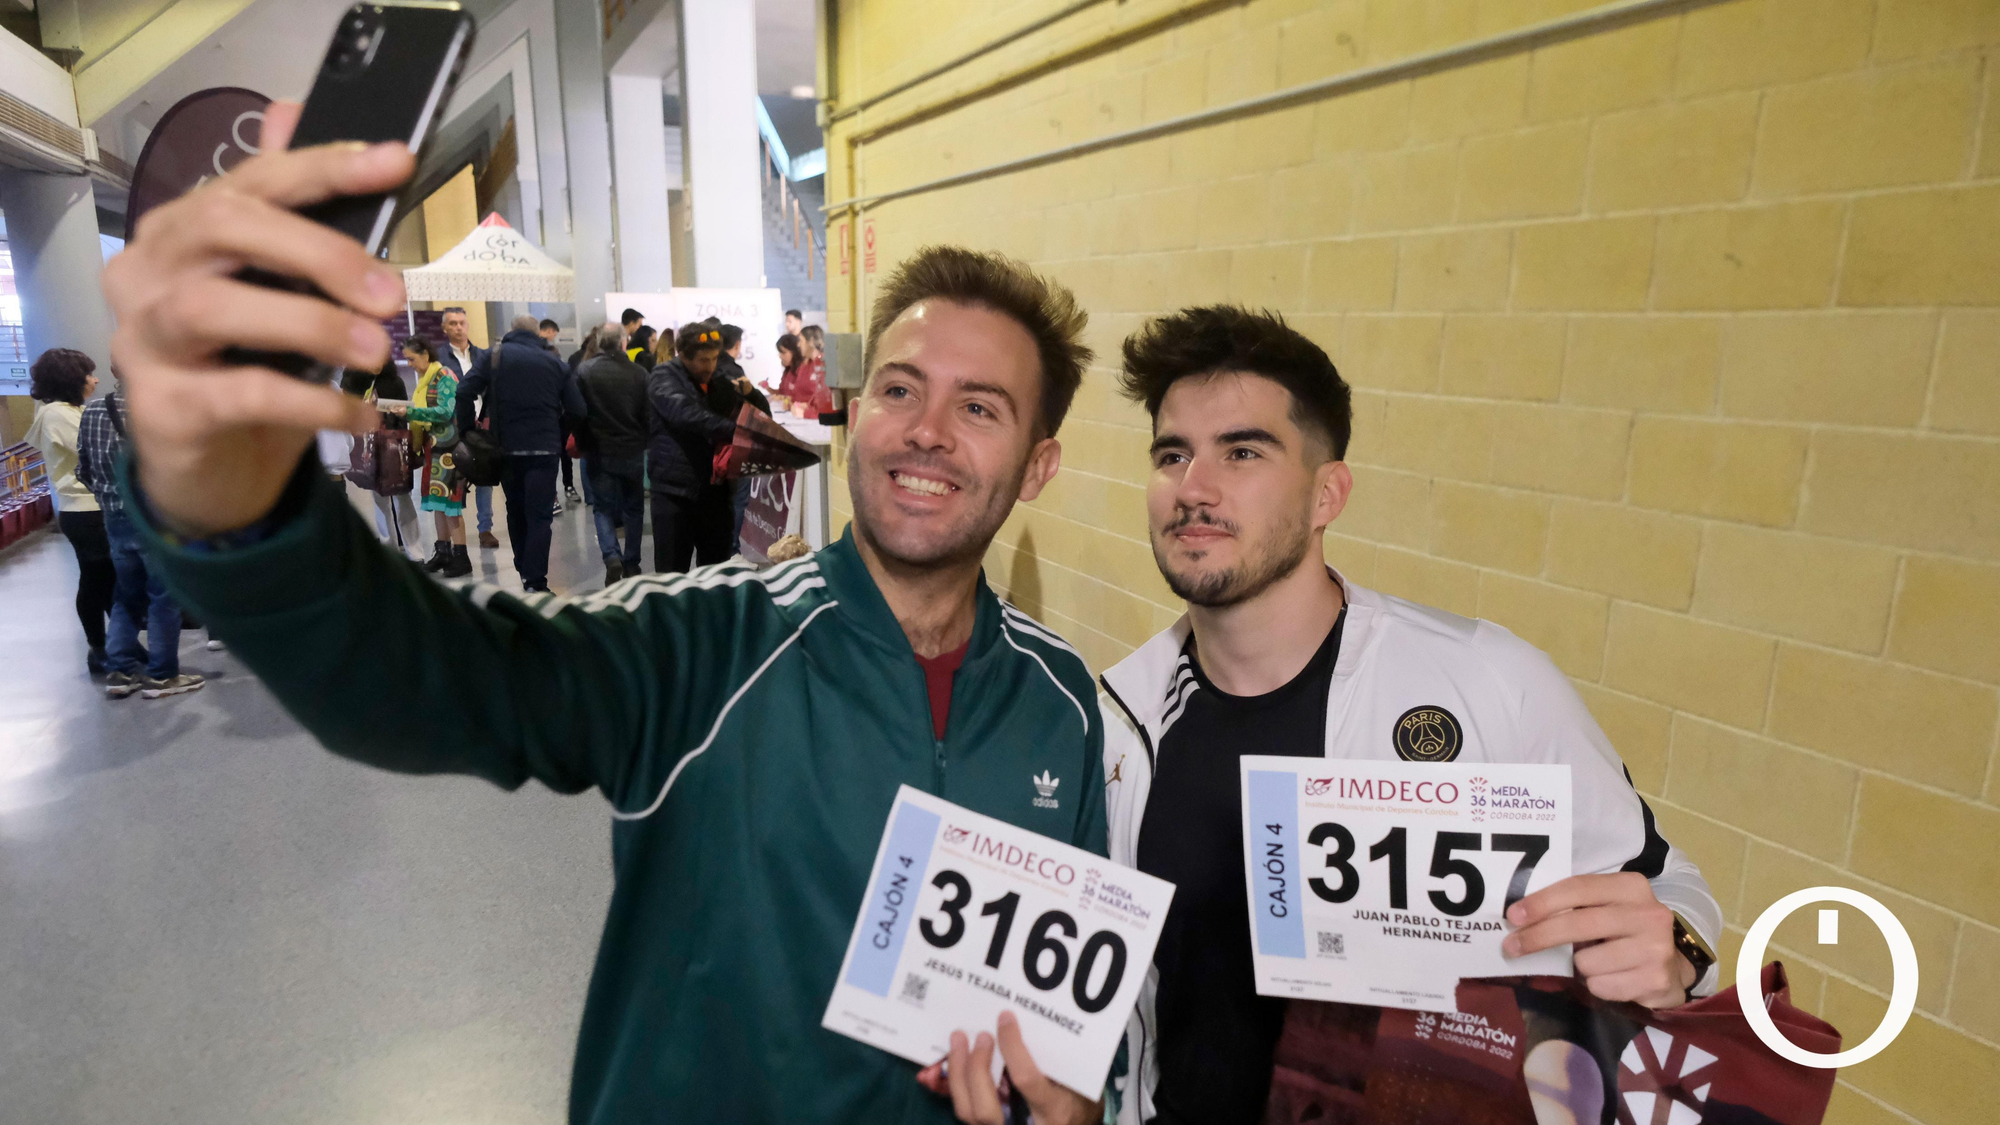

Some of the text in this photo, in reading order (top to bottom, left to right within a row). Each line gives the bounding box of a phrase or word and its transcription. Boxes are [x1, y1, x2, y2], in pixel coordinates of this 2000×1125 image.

[695, 303, 759, 318] ZONA 3
[1404, 712, 1442, 729] PARIS
[1339, 777, 1459, 804] IMDECO
[1490, 786, 1530, 797] MEDIA
[1336, 802, 1373, 813] Municipal
[1387, 806, 1423, 816] Deportes
[1470, 795, 1487, 807] 36
[1490, 796, 1556, 809] MARATÓN
[1535, 813, 1557, 821] 2022
[972, 833, 1075, 886] IMDECO
[1262, 823, 1288, 918] CAJÓN 4
[1307, 822, 1550, 920] 3157
[1101, 881, 1132, 901] MEDIA
[873, 855, 914, 950] CAJÓN 4
[1353, 909, 1503, 932] JUAN PABLO TEJADA
[919, 870, 1127, 1013] 3160
[1382, 925, 1472, 944] HERNÁNDEZ
[967, 972, 1011, 1000] TEJADA
[1416, 1011, 1436, 1026] 36
[1443, 1011, 1488, 1027] MEDIA
[1440, 1020, 1516, 1048] MARATÓN
[1488, 1044, 1513, 1060] 2022
